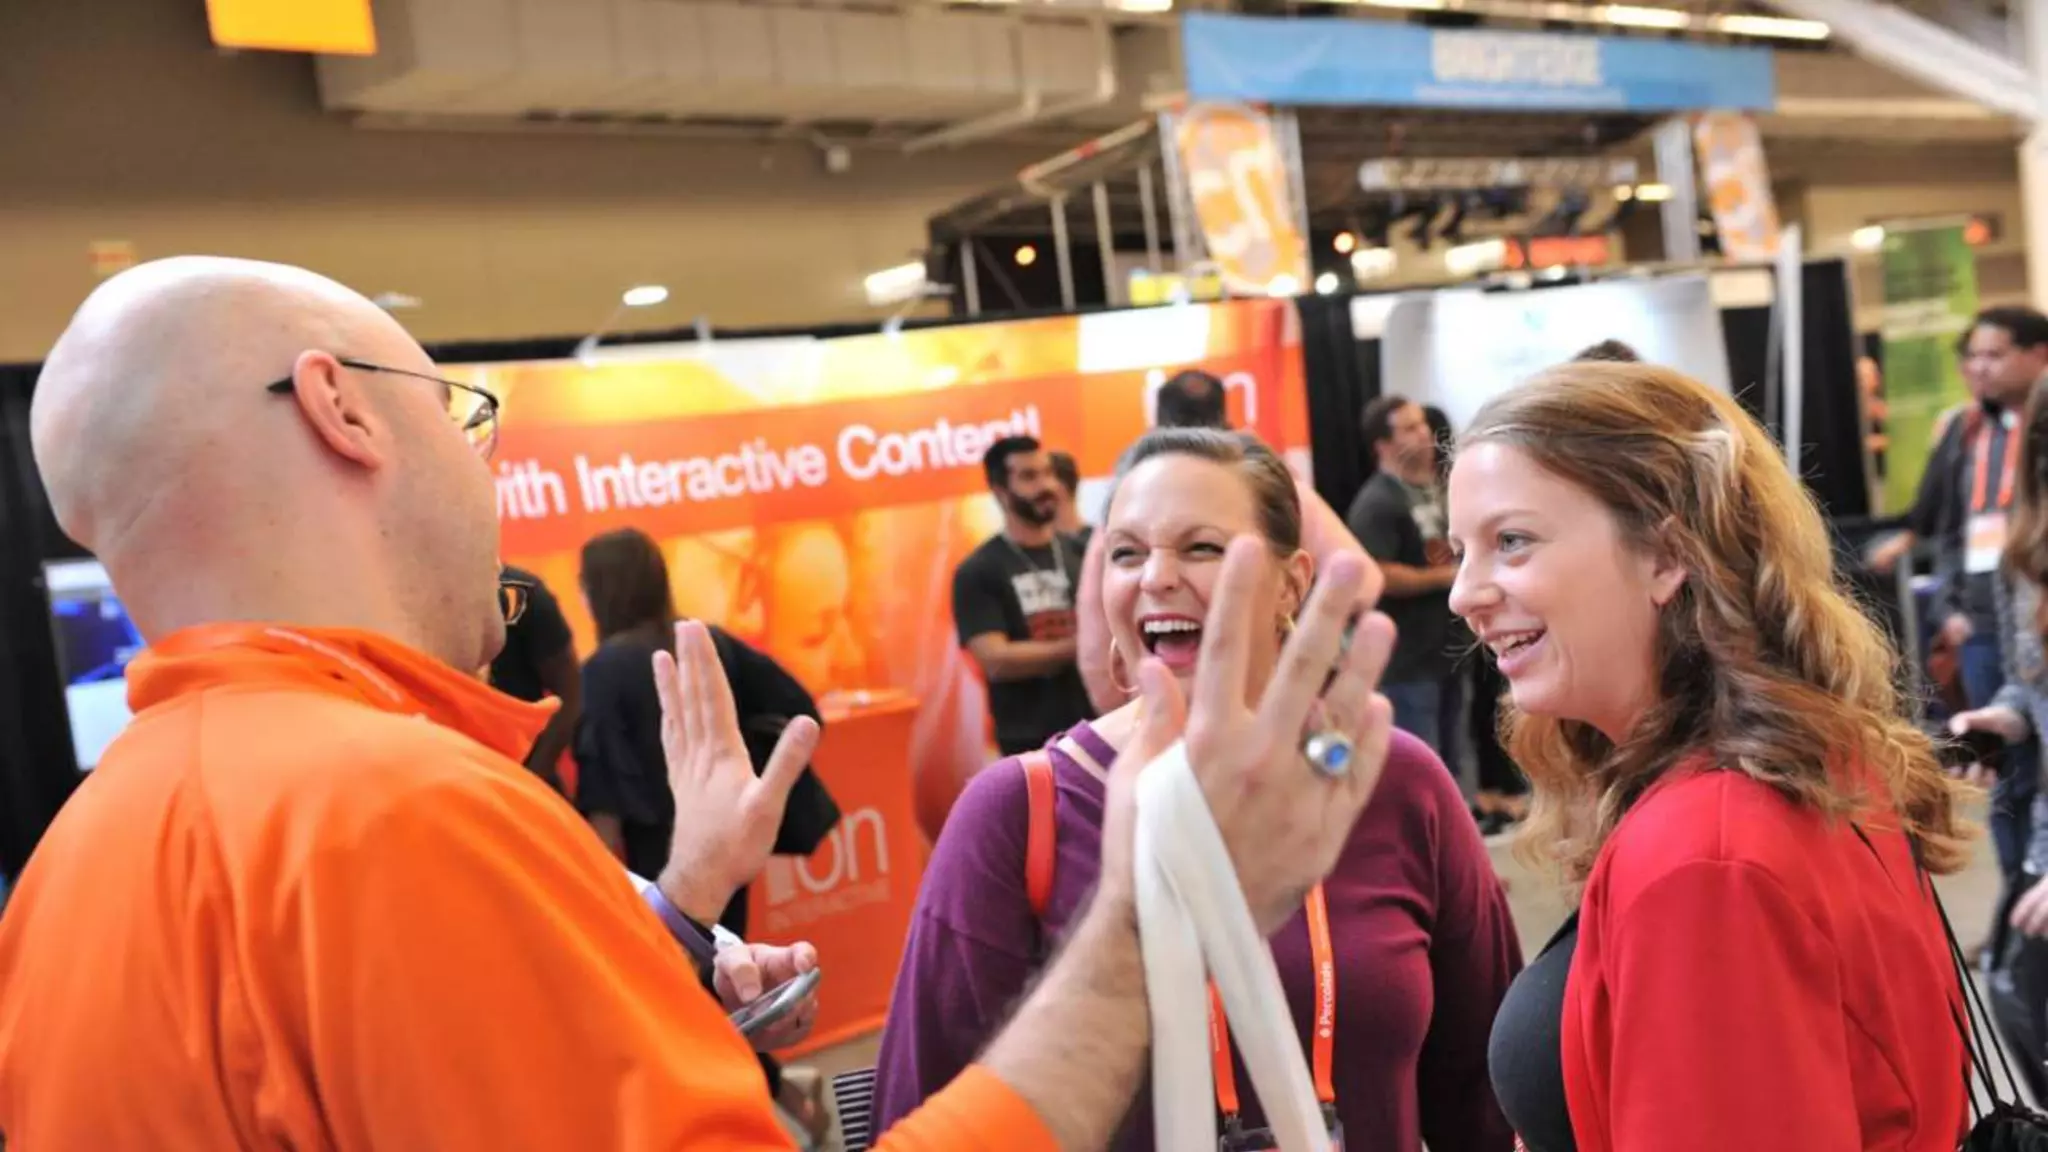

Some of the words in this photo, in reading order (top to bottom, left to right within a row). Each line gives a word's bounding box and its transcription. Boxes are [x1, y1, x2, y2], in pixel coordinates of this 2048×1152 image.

[495, 459, 568, 521] ith
[574, 437, 828, 513] Interactive
[1319, 961, 1333, 1025] Percolate
